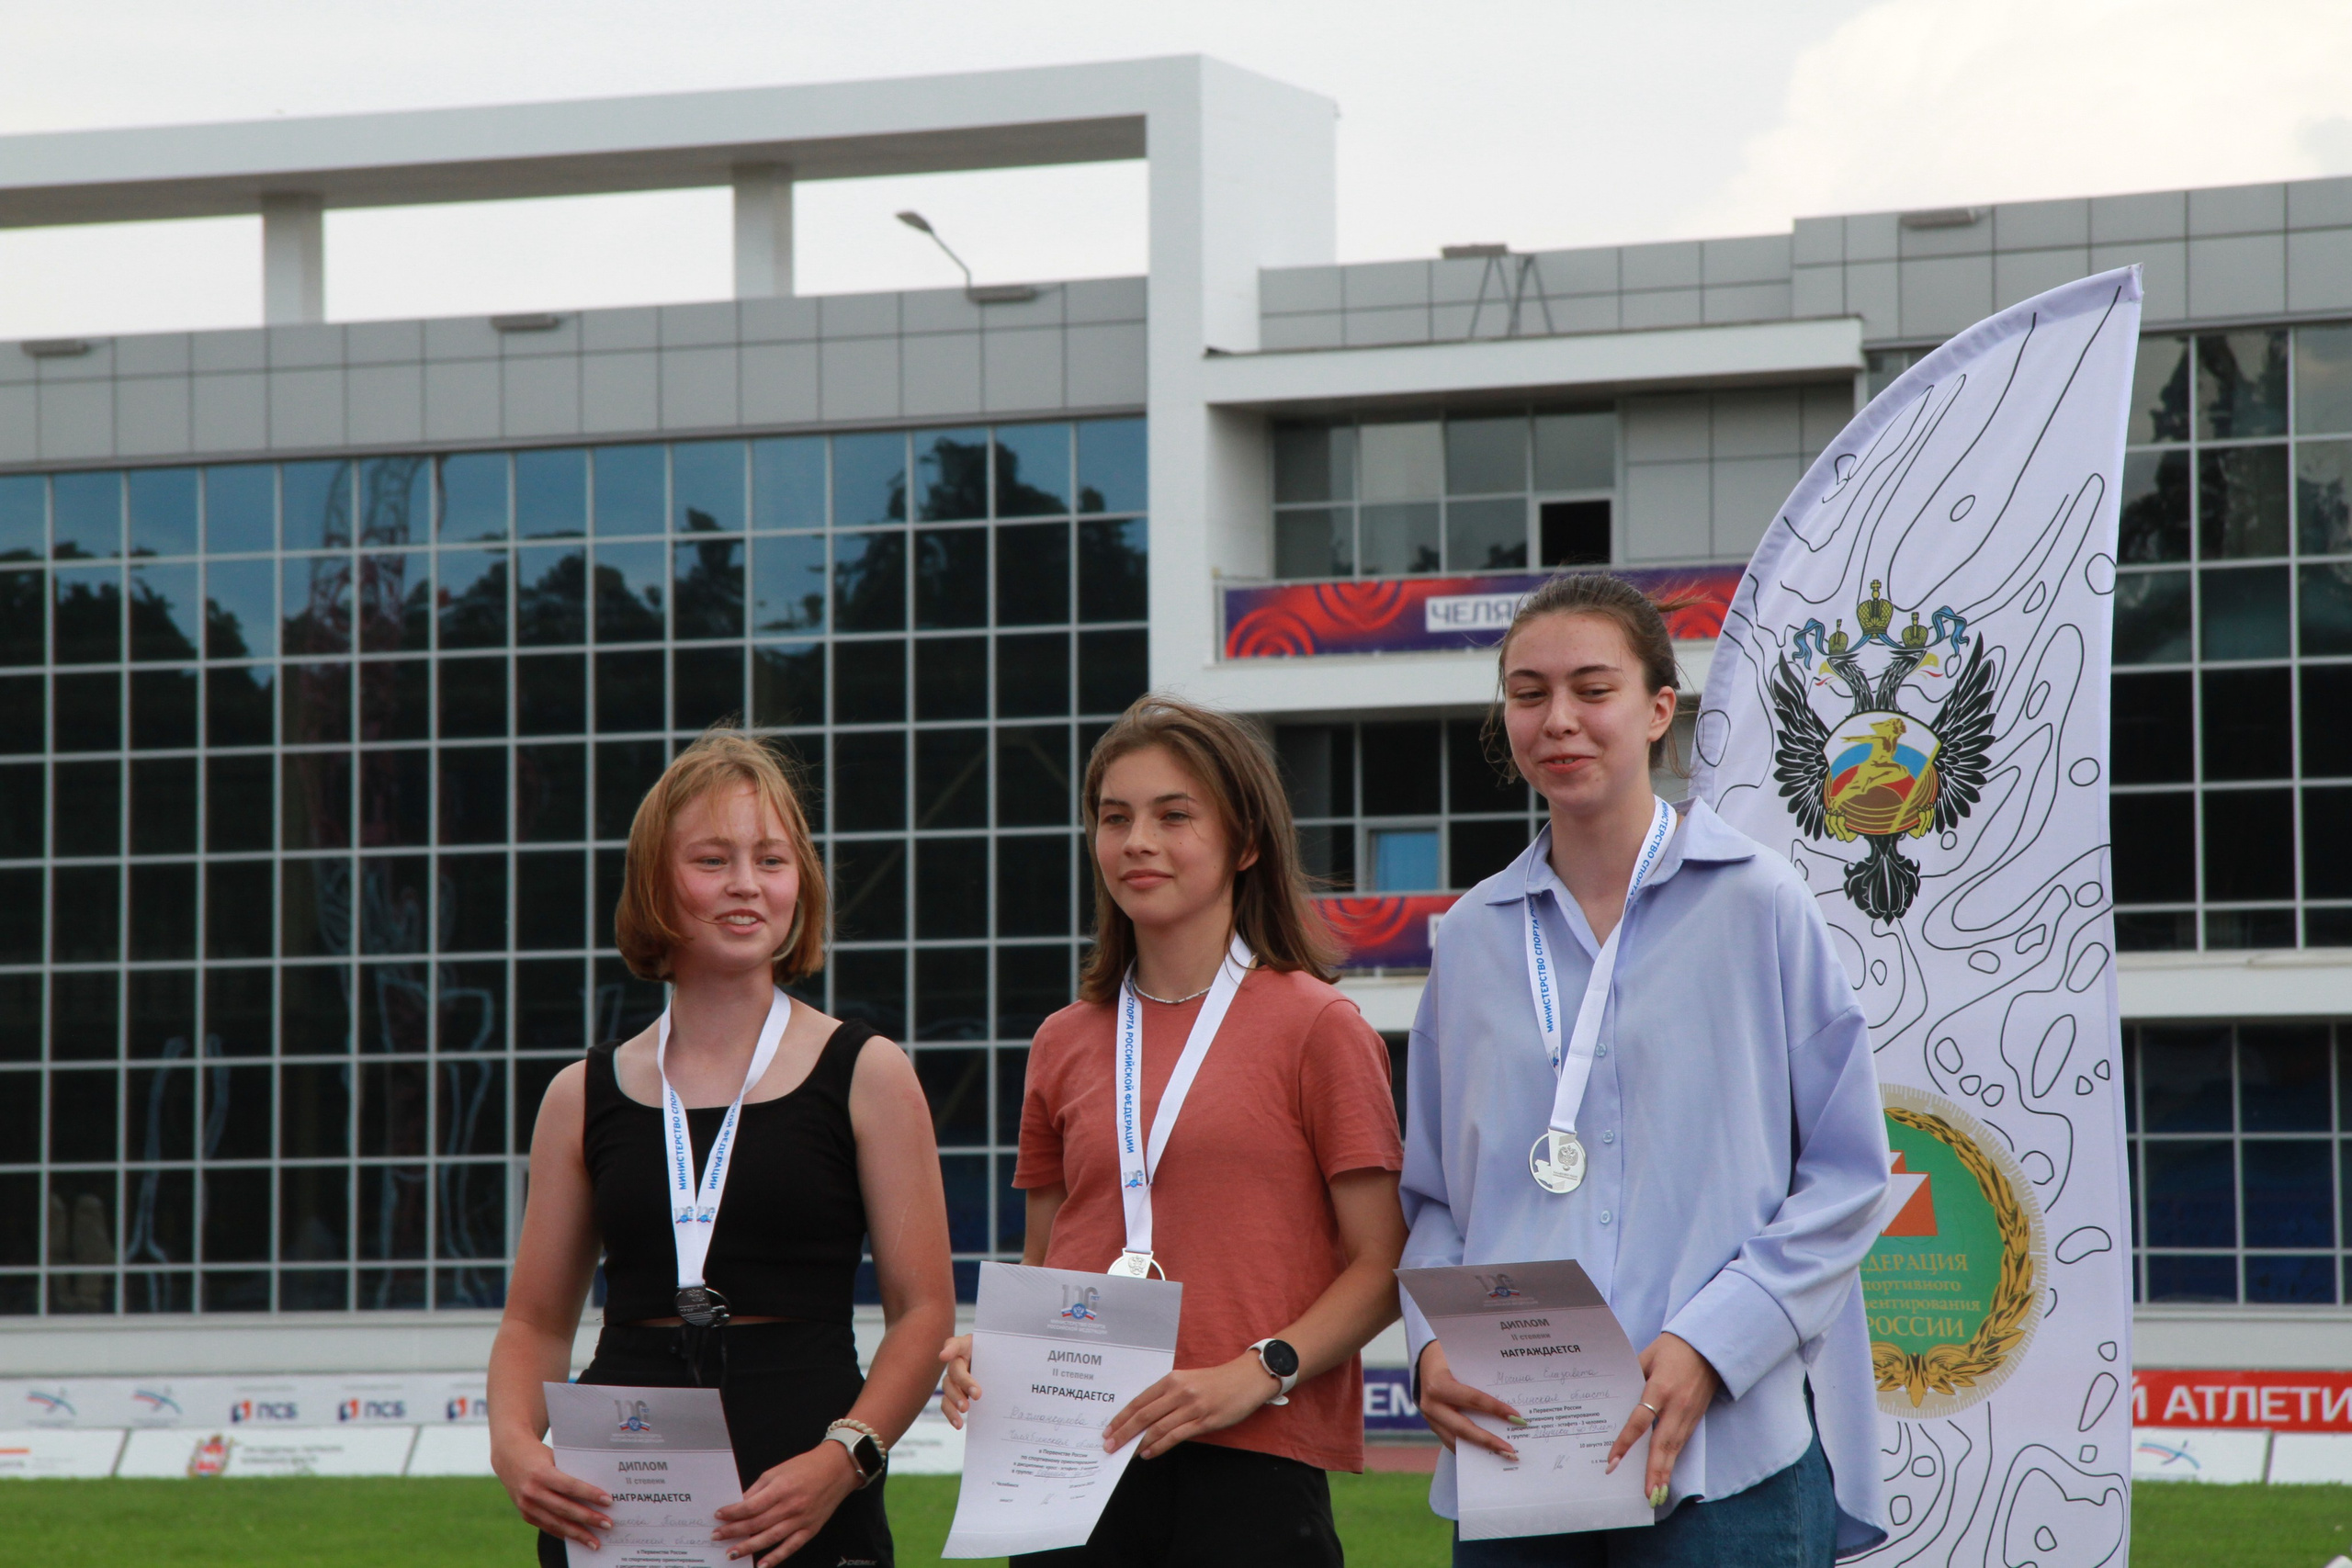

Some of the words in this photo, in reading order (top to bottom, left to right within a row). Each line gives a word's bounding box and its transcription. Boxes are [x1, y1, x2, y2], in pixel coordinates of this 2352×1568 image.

[1431, 600, 1512, 624] ЧЕЛЯ
[1532, 919, 1543, 956] СПОРТА
[1537, 957, 1555, 1032] МИНИСТЕРСТВО
[1125, 997, 1135, 1030] СПОРТА
[1124, 1032, 1136, 1091] РОССИЙСКОЙ
[1123, 1093, 1135, 1154] ФЕДЕРАЦИИ
[673, 1116, 687, 1190] МИНИСТЕРСТВО
[708, 1129, 730, 1190] ФЕДЕРАЦИИ
[1861, 1280, 1962, 1295] портивного
[1864, 1298, 1982, 1314] ентирования
[1499, 1318, 1551, 1331] ДИПЛОМ
[1047, 1349, 1102, 1366] ДИПЛОМ
[1500, 1344, 1581, 1359] НАГРАЖДАЕТСЯ
[1060, 1370, 1094, 1381] степени
[1031, 1383, 1115, 1403] НАГРАЖДАЕТСЯ
[2162, 1385, 2352, 1422] АТЛЕТИ
[1555, 1411, 1600, 1421] ориентированию
[1511, 1432, 1531, 1440] группе:
[617, 1461, 669, 1472] ДИПЛОМ
[612, 1493, 692, 1503] НАГРАЖДАЕТСЯ
